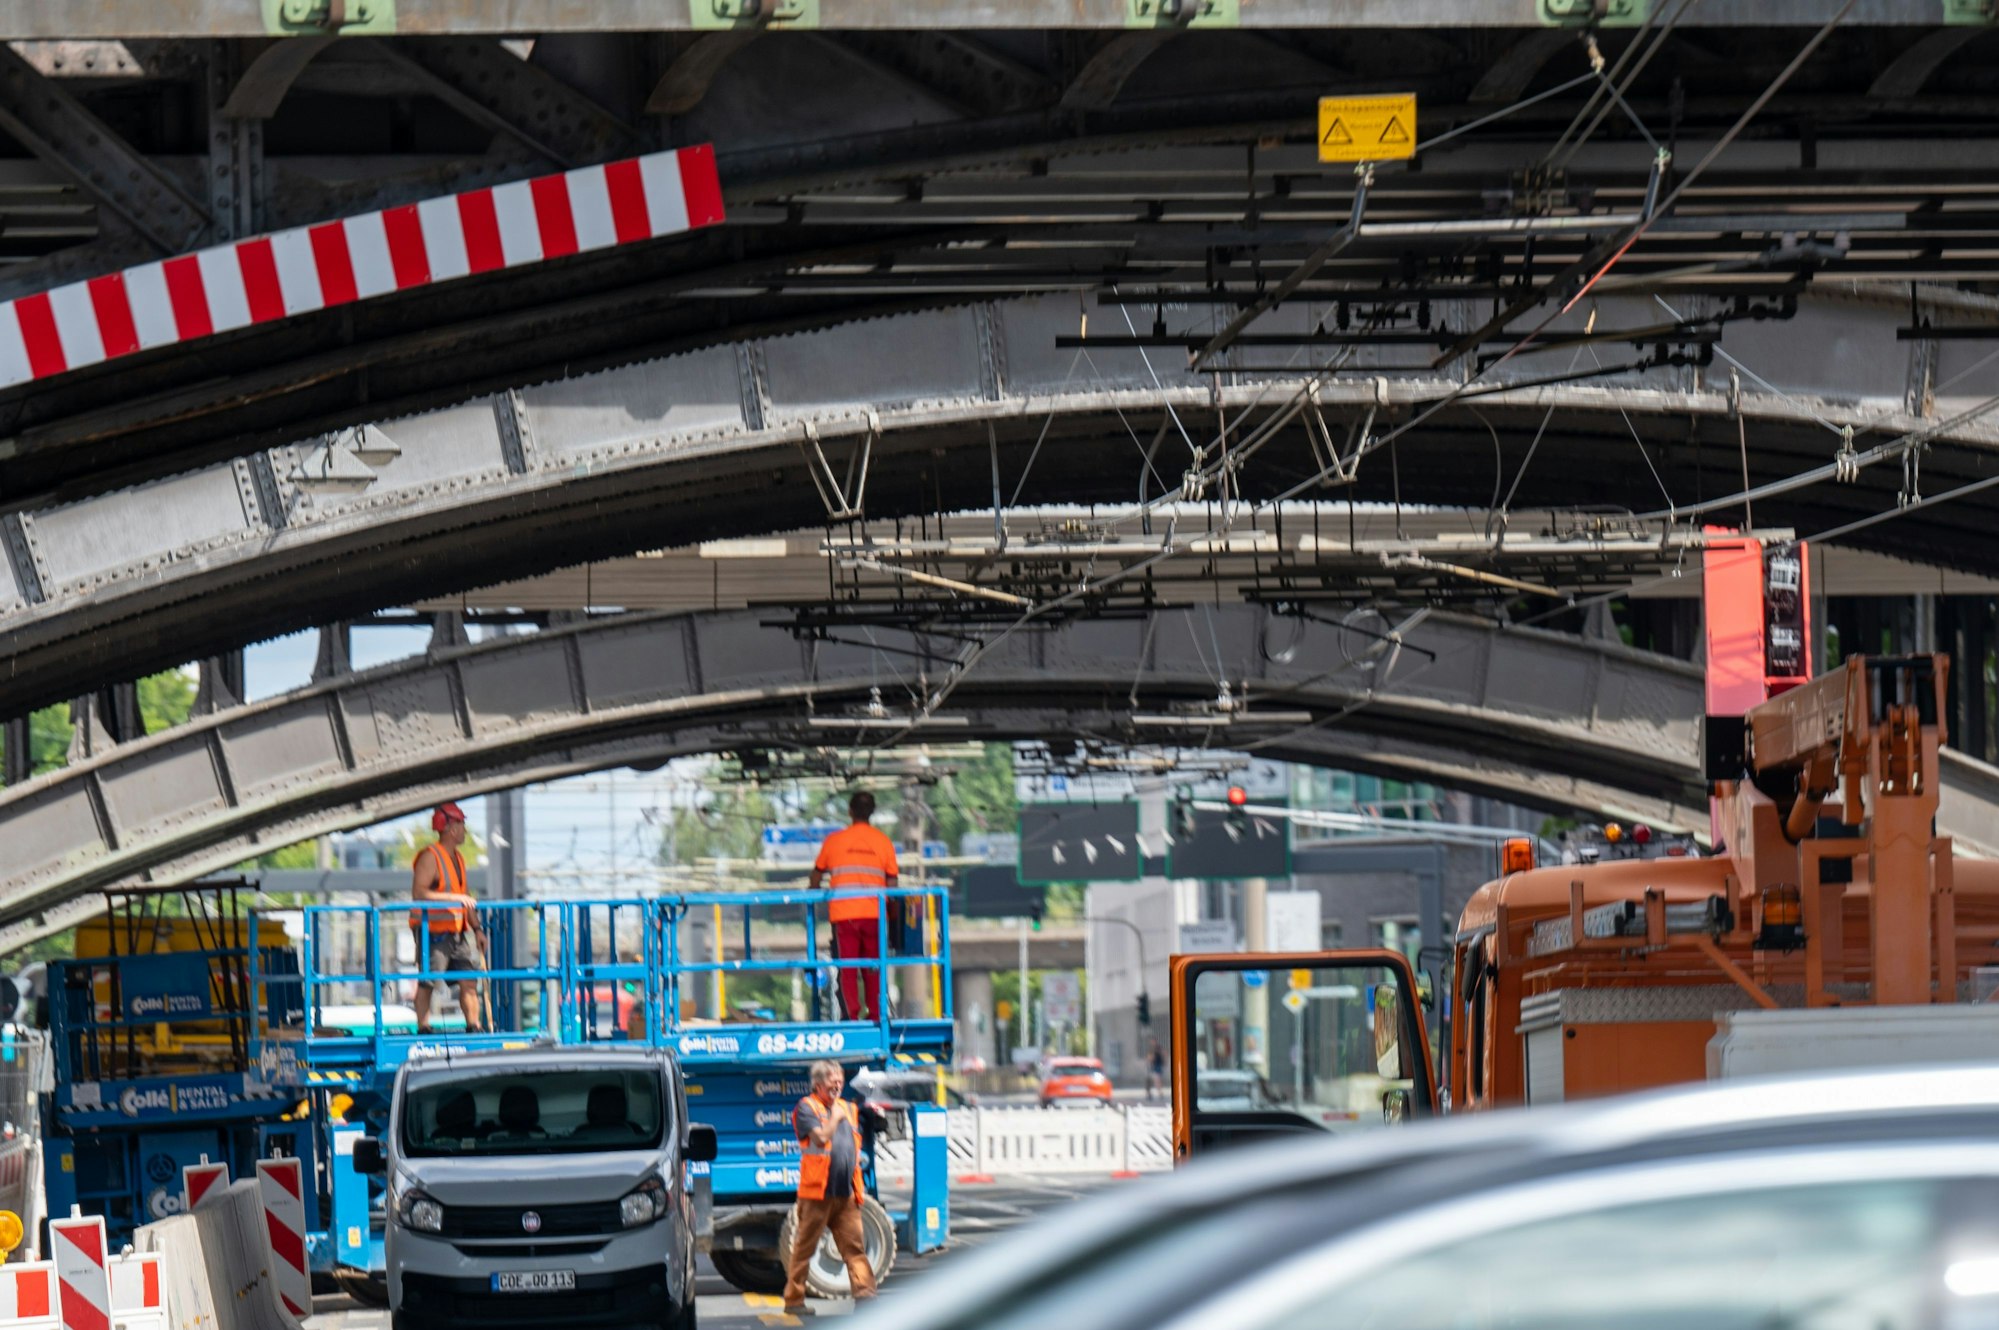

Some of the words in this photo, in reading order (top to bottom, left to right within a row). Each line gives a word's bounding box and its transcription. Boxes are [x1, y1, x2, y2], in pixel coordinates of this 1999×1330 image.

[758, 1033, 844, 1054] GS-4390
[178, 1085, 224, 1099] RENTAL
[120, 1086, 169, 1118] Collé
[190, 1095, 228, 1110] SALES
